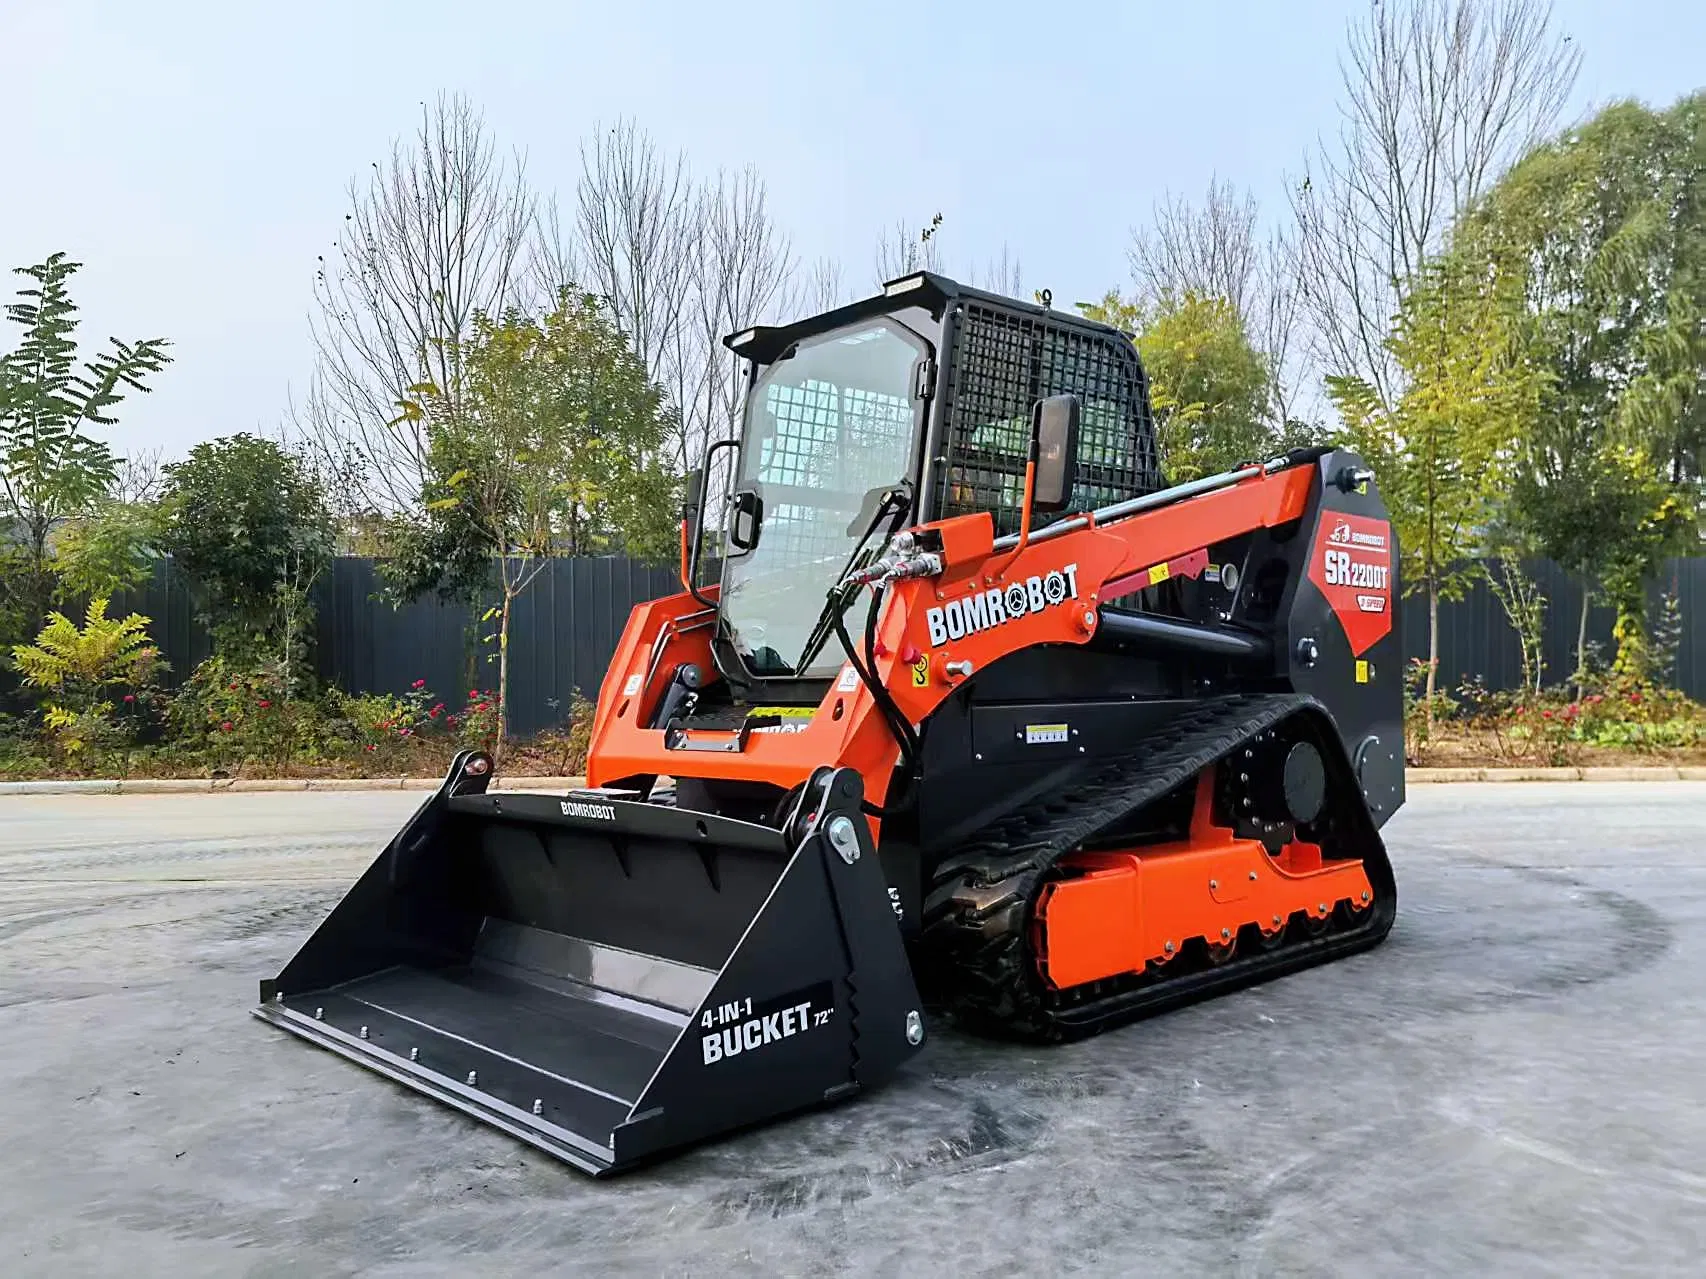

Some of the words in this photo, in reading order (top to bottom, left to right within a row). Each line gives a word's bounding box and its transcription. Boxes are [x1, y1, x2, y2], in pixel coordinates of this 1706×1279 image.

[926, 563, 1078, 647] BOMROBOT
[560, 801, 616, 820] BOMROBOT
[701, 997, 752, 1029] 4-IN-1
[702, 1001, 811, 1065] BUCKET
[813, 1007, 834, 1027] 72"
